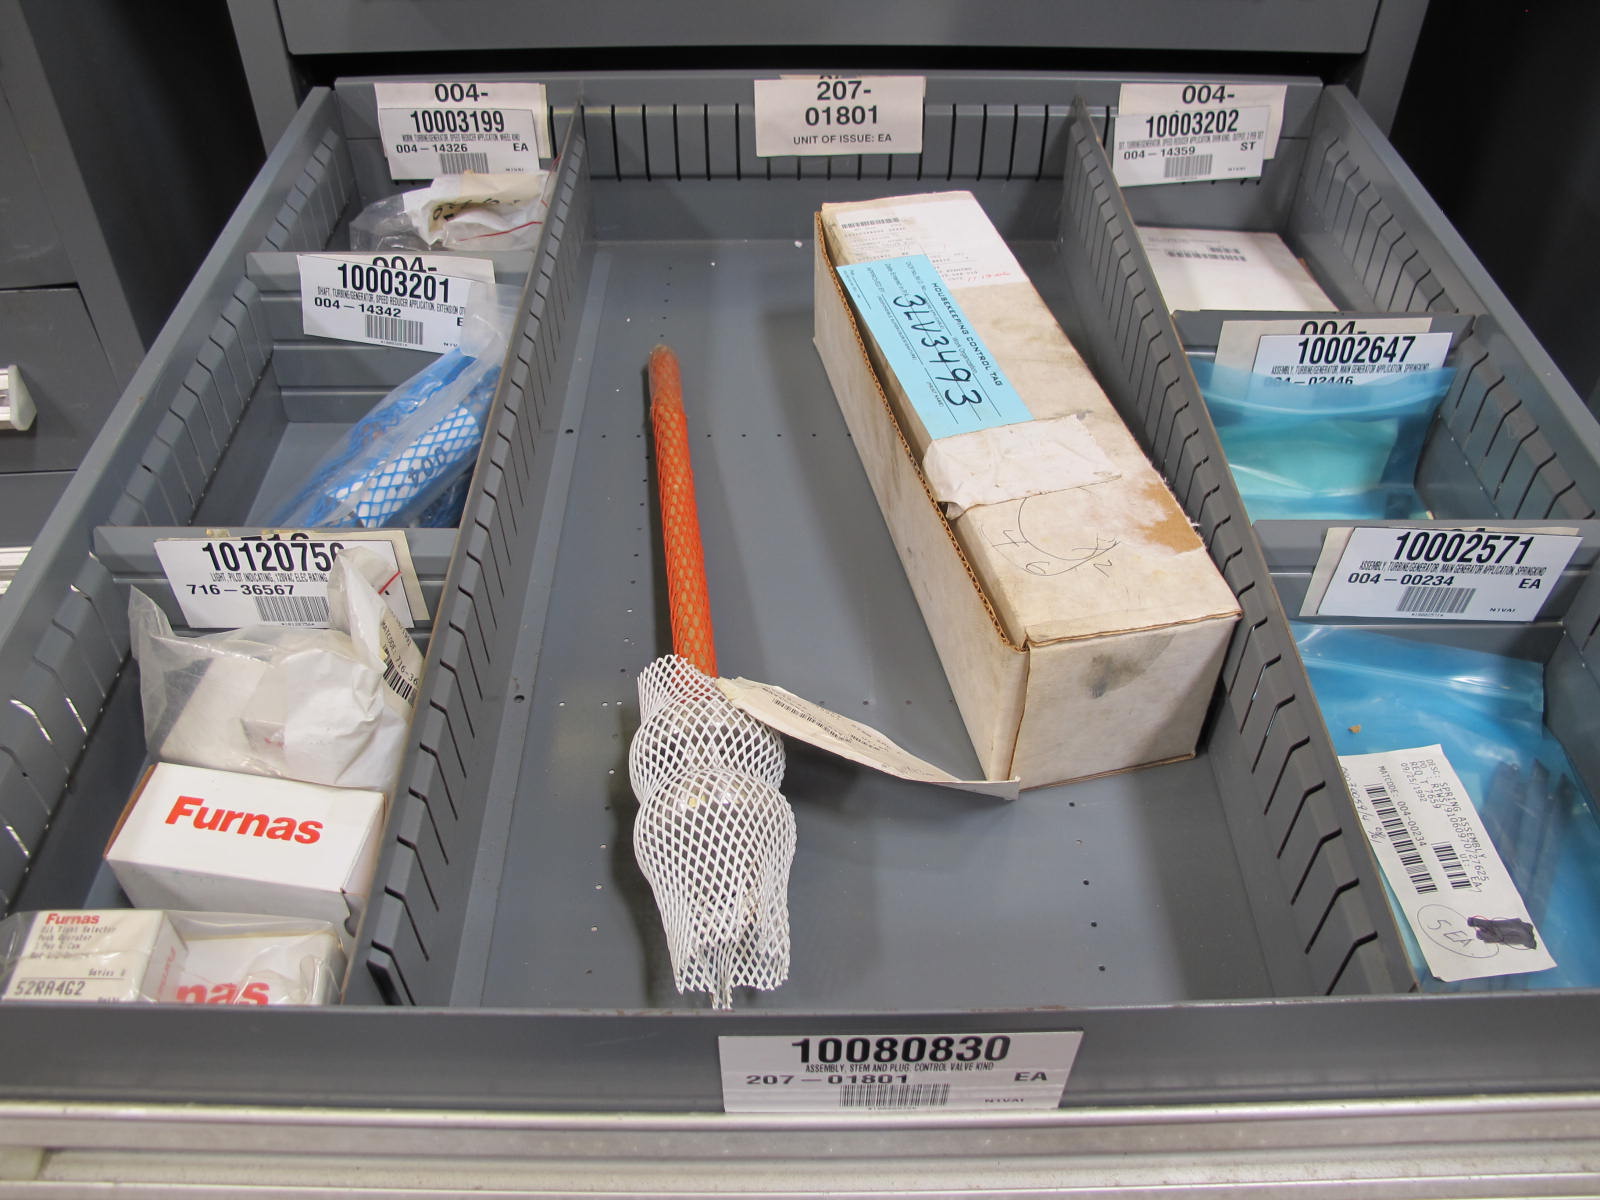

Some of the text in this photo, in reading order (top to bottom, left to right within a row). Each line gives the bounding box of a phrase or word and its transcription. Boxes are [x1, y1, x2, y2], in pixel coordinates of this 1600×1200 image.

[435, 83, 488, 102] 004-
[817, 80, 871, 100] 207-
[1182, 85, 1235, 104] 004-
[410, 110, 504, 133] 10003199
[805, 105, 878, 126] 01801
[1146, 109, 1239, 138] 10003202
[513, 143, 528, 151] EA
[793, 133, 892, 145] UNIT OF ISSUE: EA
[1240, 141, 1256, 151] ST
[338, 263, 449, 303] 10003201
[932, 282, 970, 335] HOUSEKEEPING
[967, 336, 993, 370] CONTROL
[990, 371, 1004, 386] TAG
[1298, 336, 1416, 364] 10002647
[1393, 532, 1534, 565] 10002571
[1518, 578, 1541, 589] EA
[1410, 761, 1424, 776] REQ
[1425, 788, 1442, 809] 7659
[1379, 765, 1427, 847] MATCODE: 004-00234
[1426, 759, 1487, 859] DESC: SPRING ASSEMBLY
[165, 795, 323, 844] Furnas
[1470, 876, 1482, 888] EA
[45, 913, 100, 925] Furnas
[792, 1035, 1011, 1063] 10080830
[806, 1063, 847, 1074] ASSEMBLY,
[849, 1063, 870, 1072] STEM
[873, 1063, 888, 1072] AND
[914, 1062, 947, 1072] CONTROL
[951, 1062, 973, 1071] VALVE
[976, 1062, 994, 1071] KIND
[1014, 1071, 1048, 1082] EA
